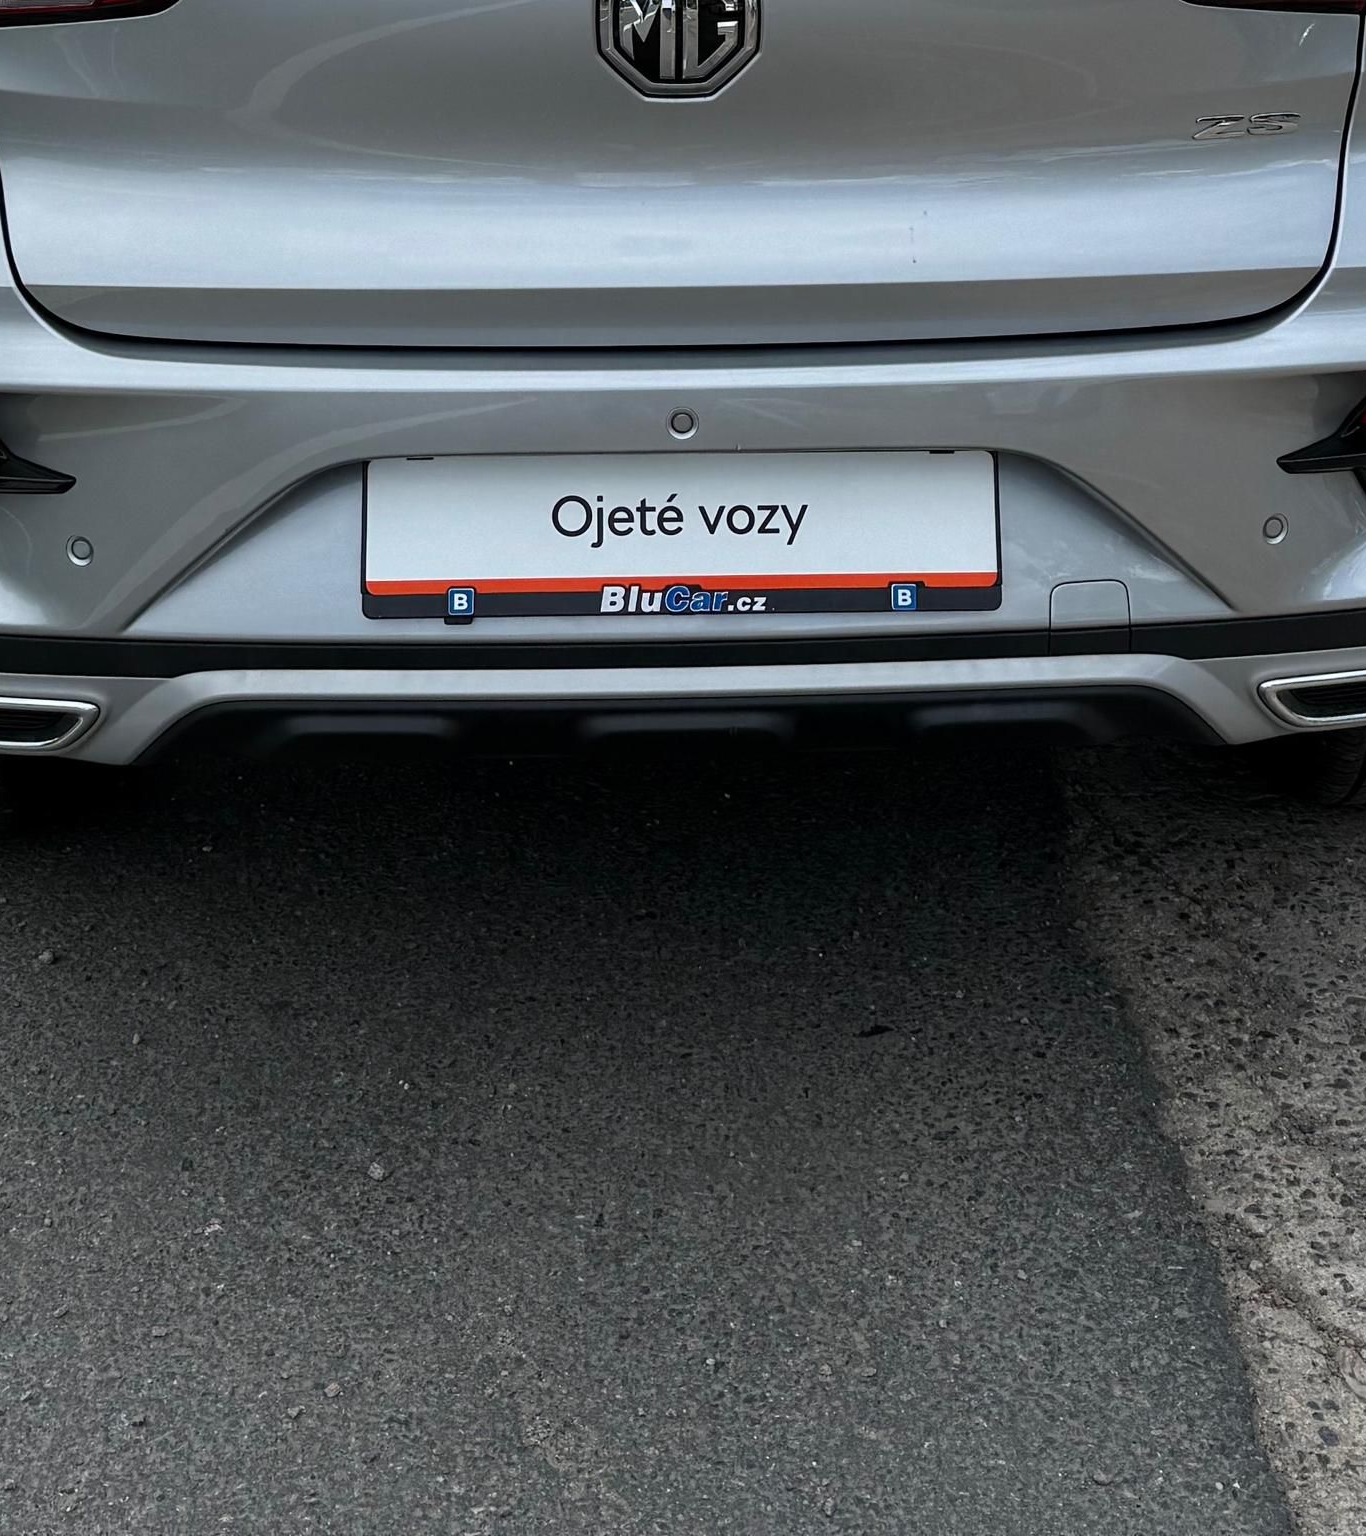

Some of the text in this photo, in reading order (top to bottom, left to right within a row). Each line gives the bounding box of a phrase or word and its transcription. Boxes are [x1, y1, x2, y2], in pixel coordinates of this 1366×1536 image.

[1191, 112, 1302, 141] ZS
[551, 493, 809, 548] Ojeté vozy
[453, 593, 468, 611] B
[600, 585, 767, 613] BluCar.cz
[897, 589, 912, 606] B
